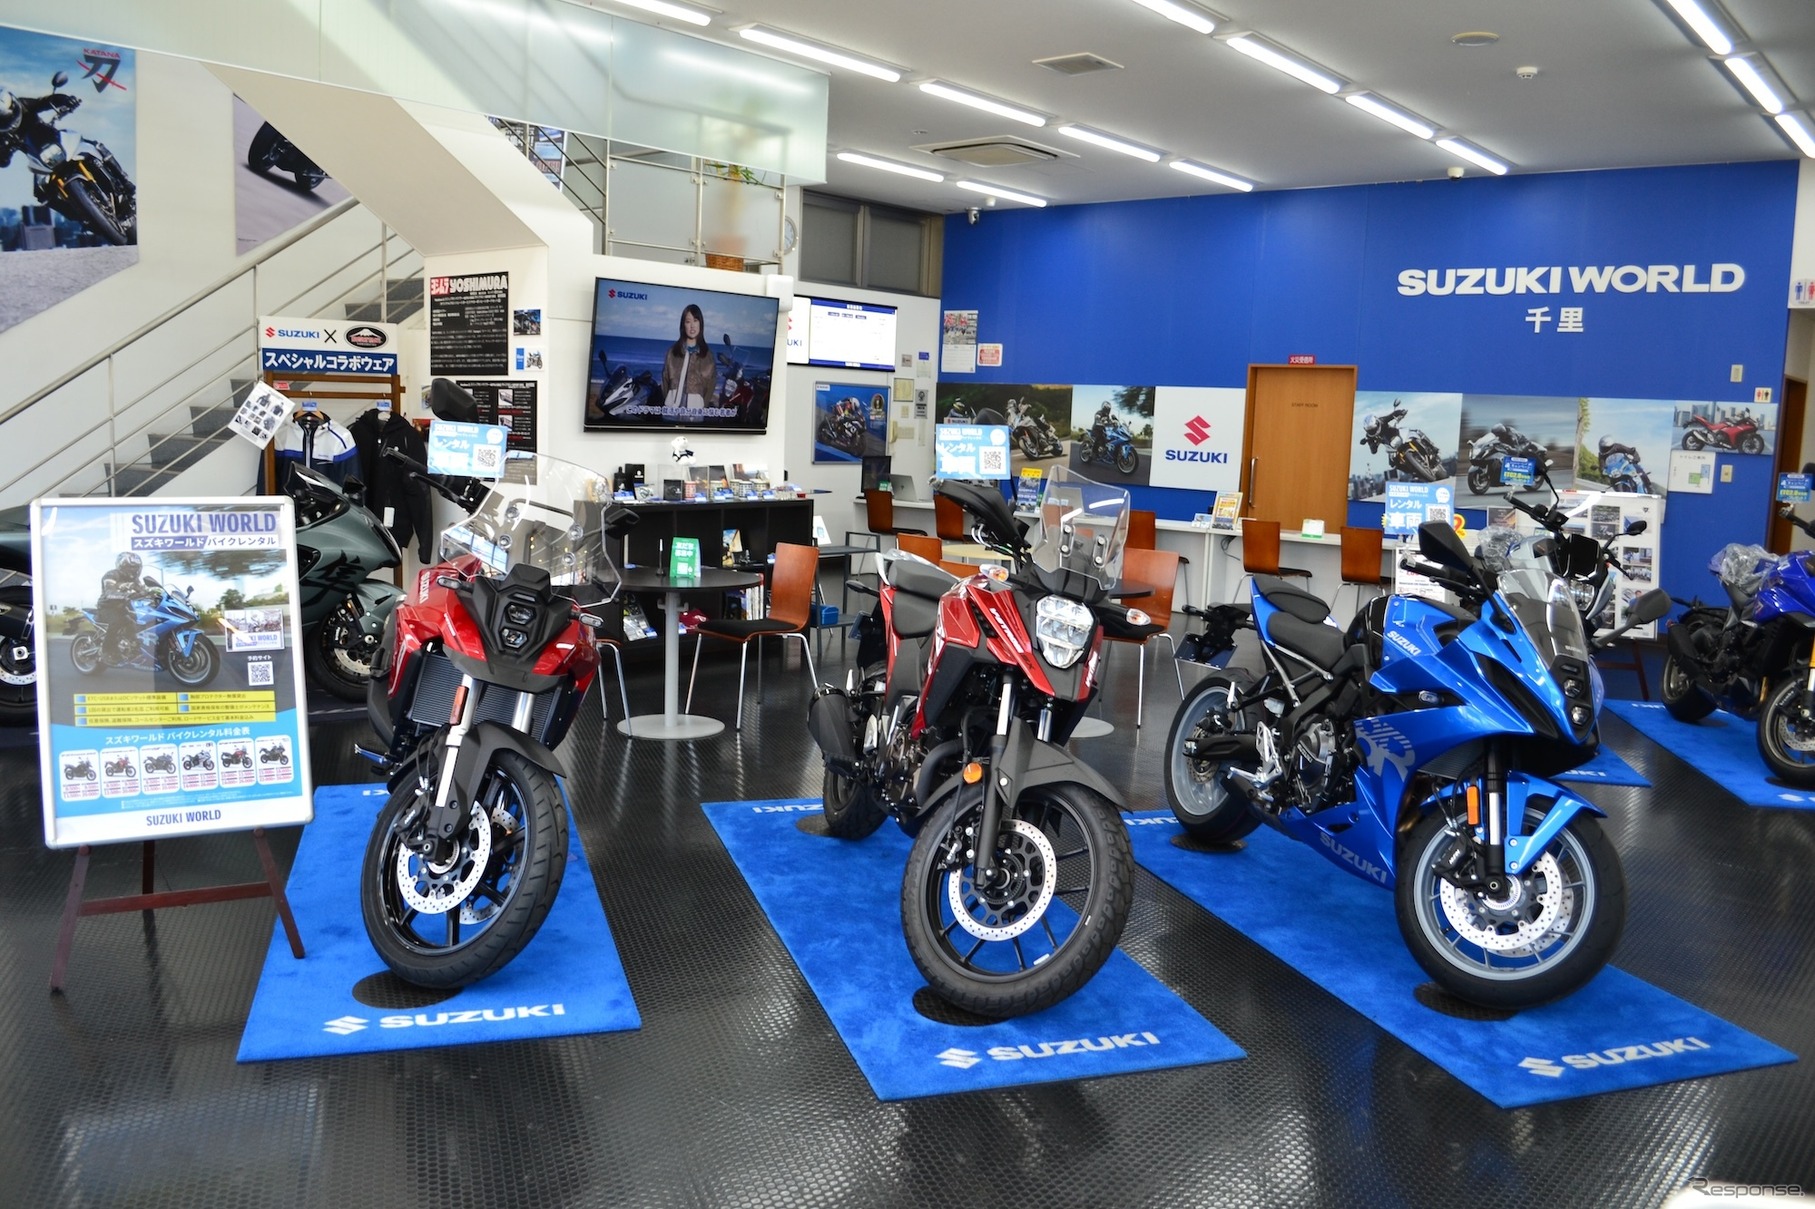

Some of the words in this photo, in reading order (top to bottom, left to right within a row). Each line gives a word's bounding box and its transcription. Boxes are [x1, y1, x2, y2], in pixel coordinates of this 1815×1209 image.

[83, 48, 120, 58] KATANA
[450, 275, 508, 293] YOSHIMURA
[1397, 266, 1561, 296] SUZUKI
[1568, 263, 1745, 294] WORLD
[617, 291, 647, 300] SUZUKI
[1525, 306, 1584, 333] 千里
[278, 329, 319, 338] SUZUKI
[786, 338, 802, 346] UKI
[265, 353, 394, 371] スペシャルコラボウェア
[1165, 450, 1228, 464] SUZUKI
[1389, 485, 1409, 493] SUZUKI
[1410, 485, 1428, 493] WORLD
[1389, 499, 1421, 509] レンタル
[132, 514, 201, 534] SUZUKI
[209, 513, 276, 533] WORLD
[134, 537, 205, 548] スズキワールド
[207, 536, 276, 546] バイクレンタル
[1387, 630, 1421, 656] SUZUKI
[105, 733, 165, 745] スズキワールド
[167, 726, 250, 741] バイクレンタル料金表
[752, 803, 824, 814] ZUKI
[146, 813, 183, 826] SUZUKI
[186, 809, 222, 823] WORLD
[1123, 816, 1179, 826] UKI
[1320, 832, 1387, 883] SUZUKI
[380, 1003, 565, 1029] SUZUKI
[986, 1032, 1161, 1062] SUZUKI
[1562, 1036, 1711, 1070] SUZUKI
